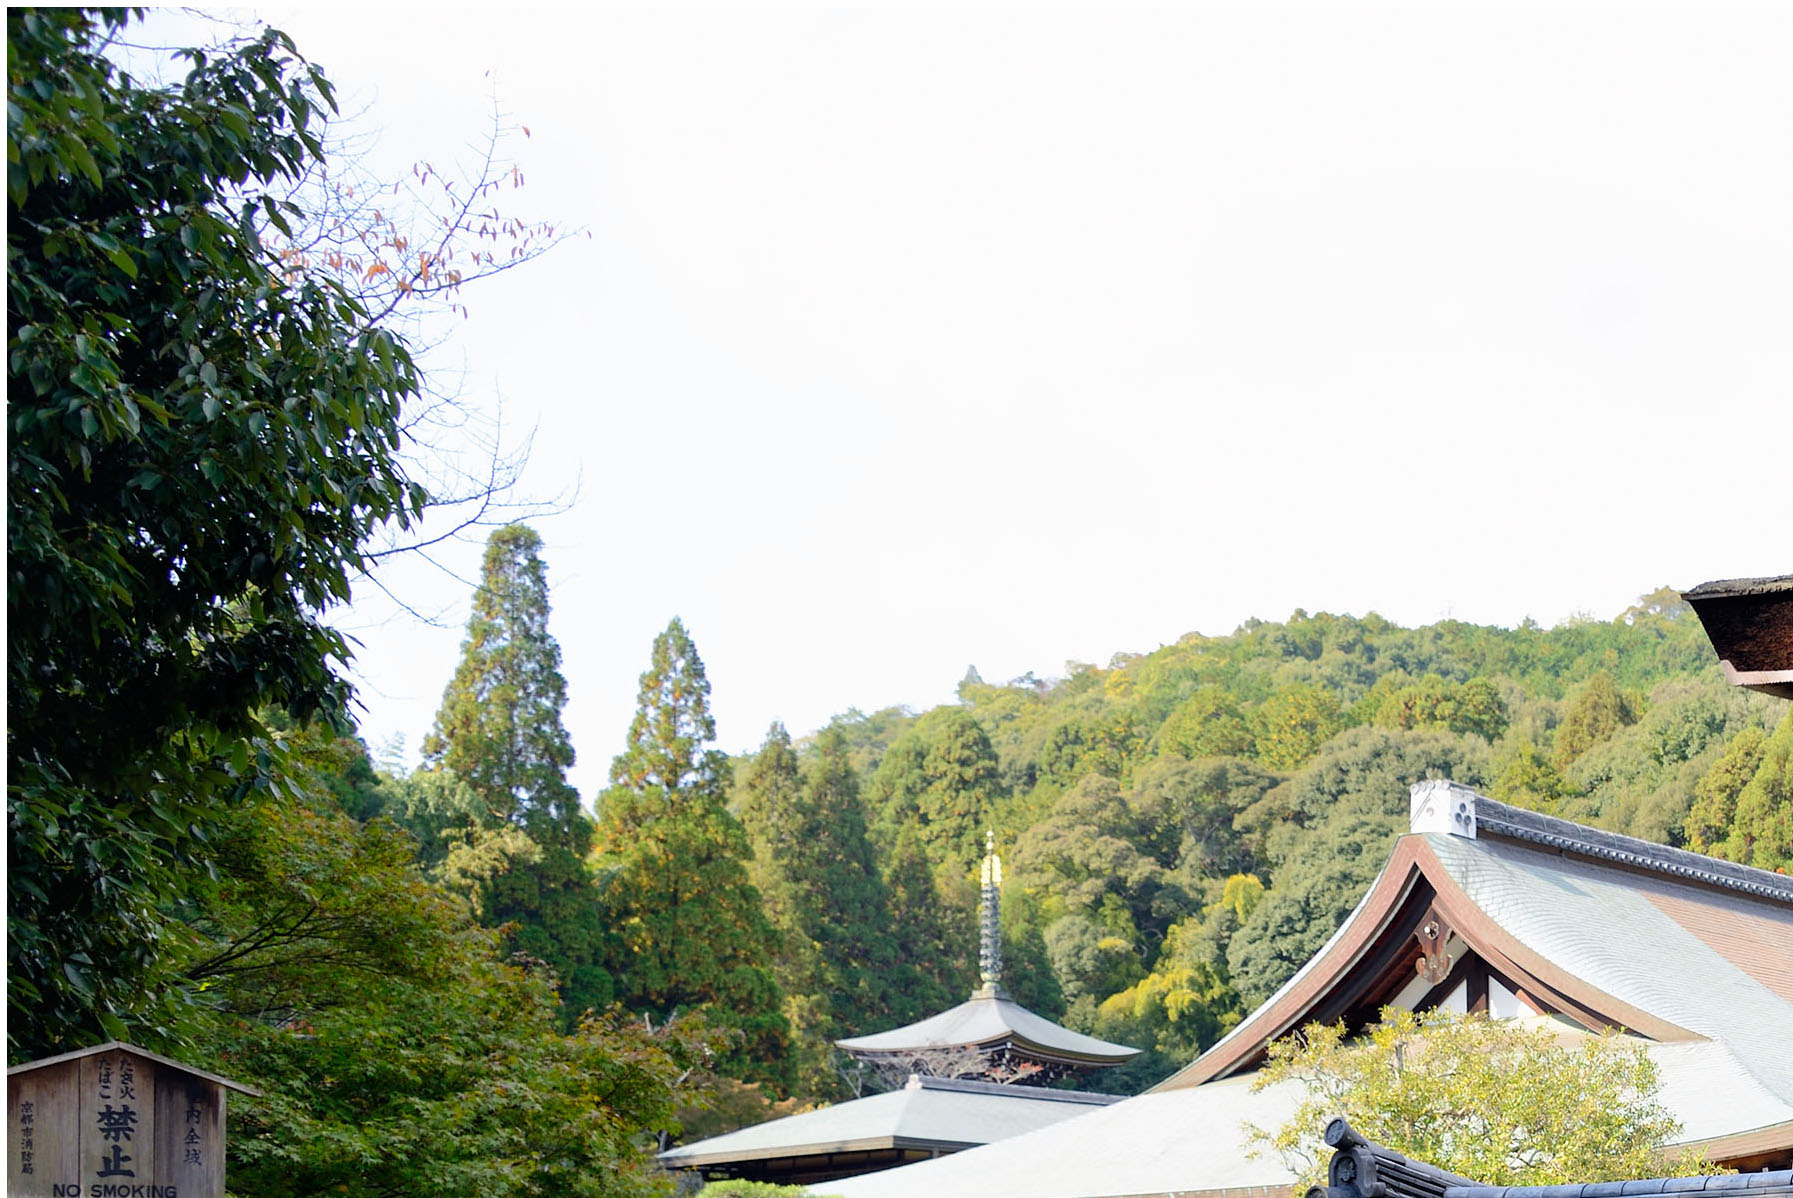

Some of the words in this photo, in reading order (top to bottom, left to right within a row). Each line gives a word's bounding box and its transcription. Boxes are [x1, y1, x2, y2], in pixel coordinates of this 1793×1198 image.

[99, 1057, 113, 1100] たばこ
[20, 1101, 34, 1175] 京都市消防局
[96, 1104, 138, 1178] 禁止
[183, 1089, 202, 1167] 内全域
[52, 1184, 81, 1198] NO
[90, 1184, 178, 1198] SMOKING
